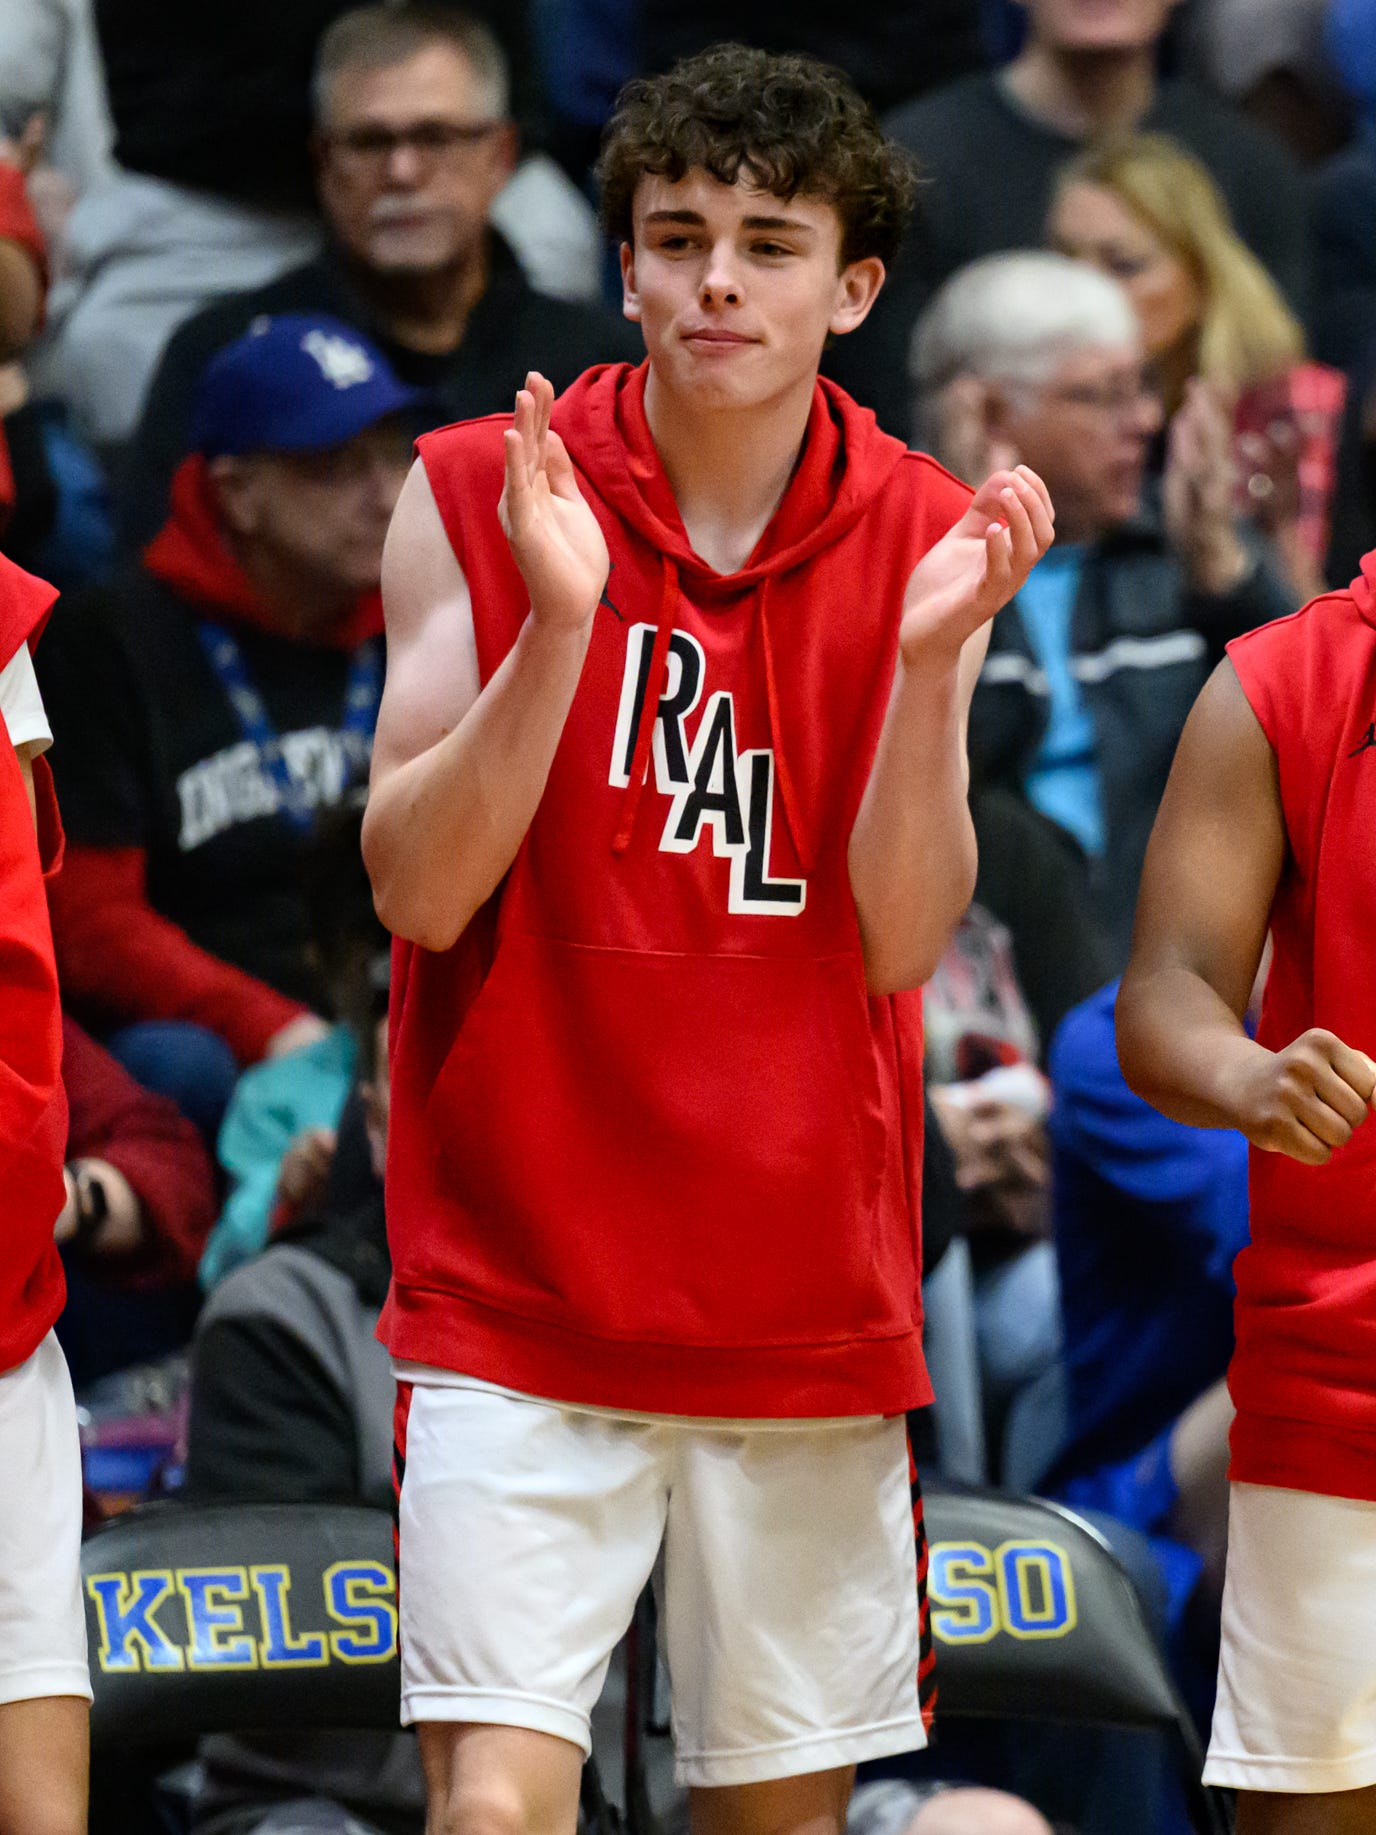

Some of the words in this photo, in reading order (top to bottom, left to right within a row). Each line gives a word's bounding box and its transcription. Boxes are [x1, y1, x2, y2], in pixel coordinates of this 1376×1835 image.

[609, 623, 807, 916] RAL
[88, 1560, 397, 1672] KELS
[926, 1539, 1078, 1645] SO
